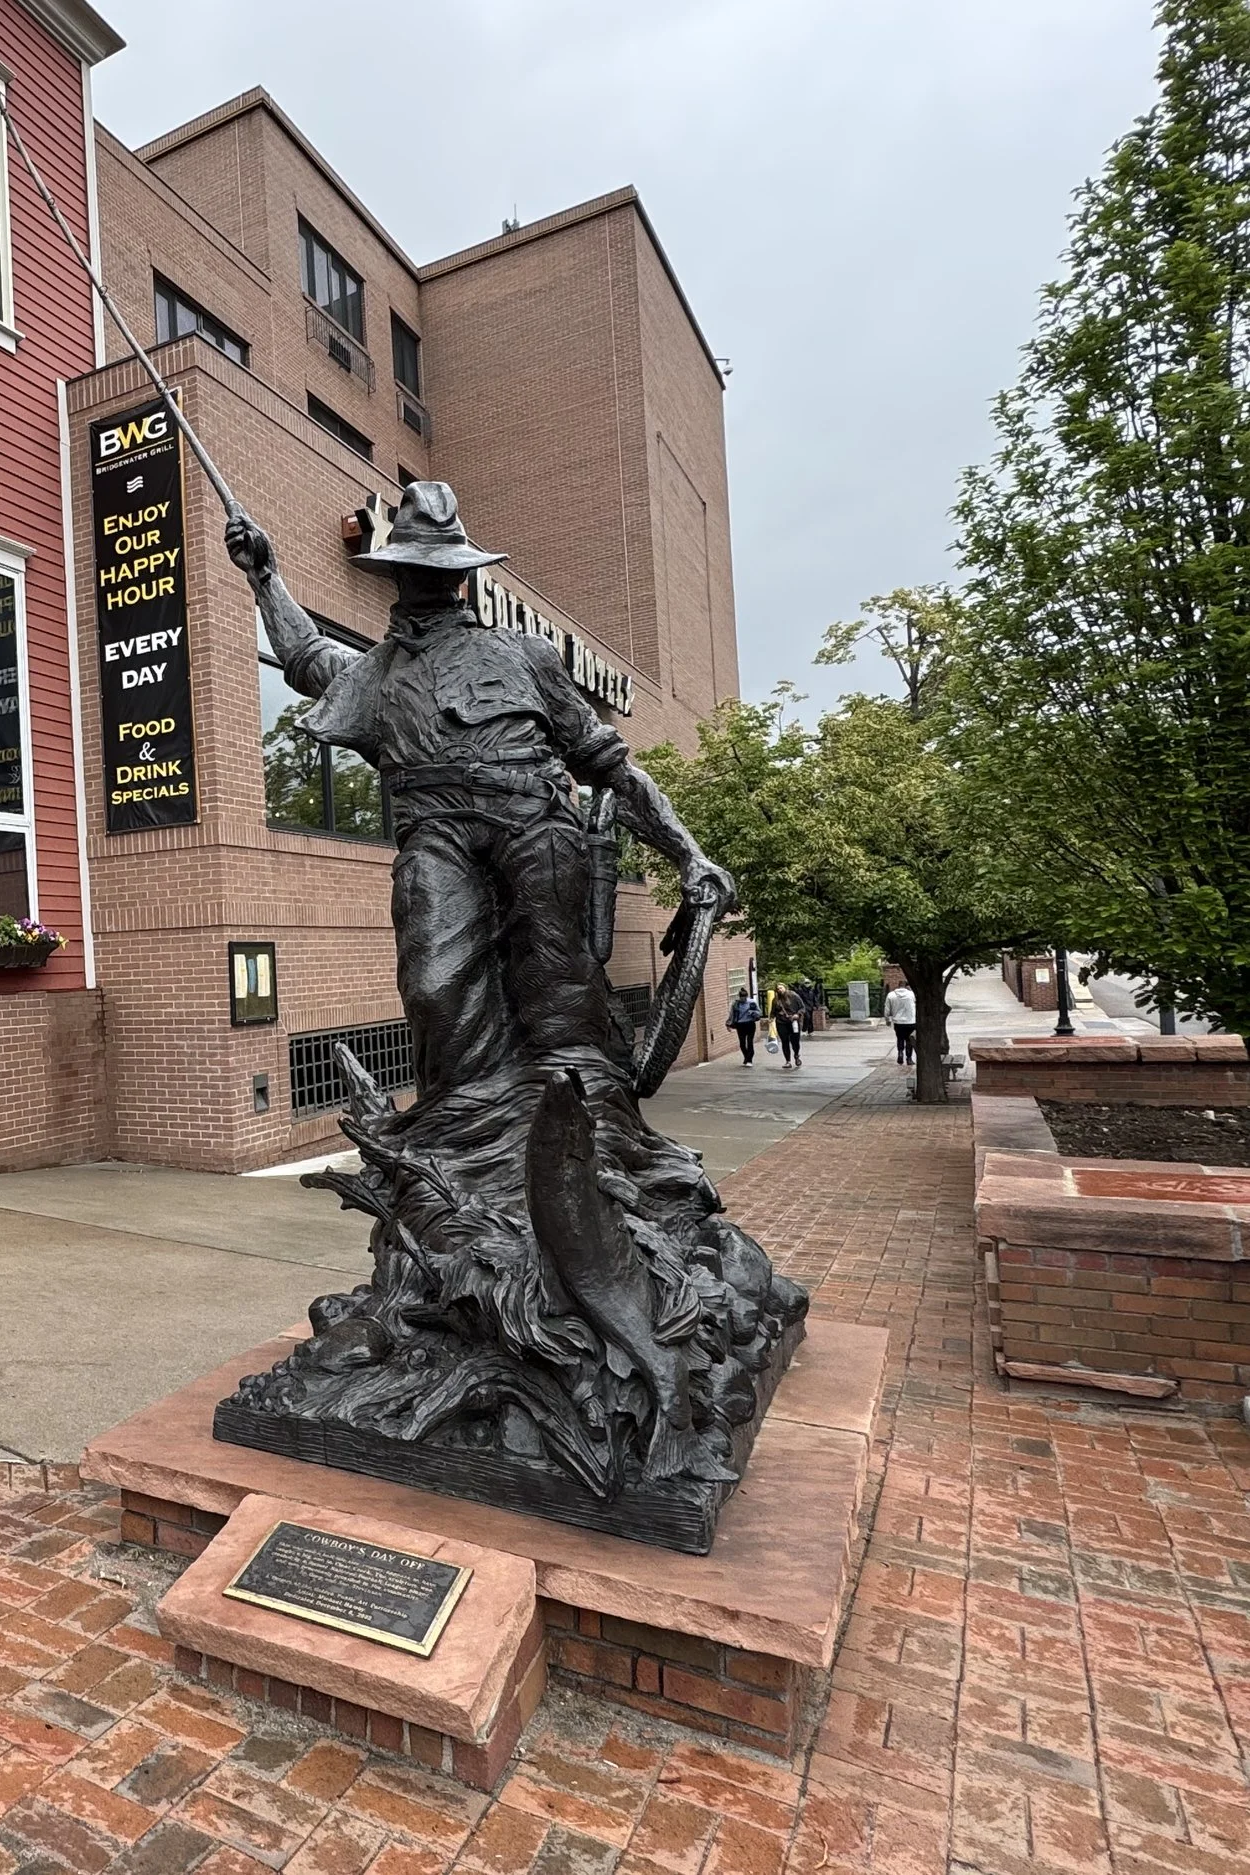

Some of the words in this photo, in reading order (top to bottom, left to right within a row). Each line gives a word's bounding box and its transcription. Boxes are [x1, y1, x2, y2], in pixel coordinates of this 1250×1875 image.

[99, 411, 168, 457] BWG
[95, 453, 148, 475] BRIDGEWATER
[149, 443, 175, 456] GRILL
[103, 500, 171, 536] ENJOY
[114, 529, 161, 555] OUR
[100, 547, 180, 587] HAPPY
[106, 576, 176, 610] HOUR
[104, 626, 183, 662] EVERY
[121, 662, 168, 690] DAY
[572, 632, 626, 714] HOTEL
[118, 717, 175, 742] FOOD
[138, 741, 156, 761] &
[116, 759, 182, 785] DRINK
[111, 782, 190, 805] SPECIALS
[303, 1534, 366, 1553] COWBOY'S
[371, 1551, 395, 1561] DAY
[400, 1558, 425, 1569] OFF
